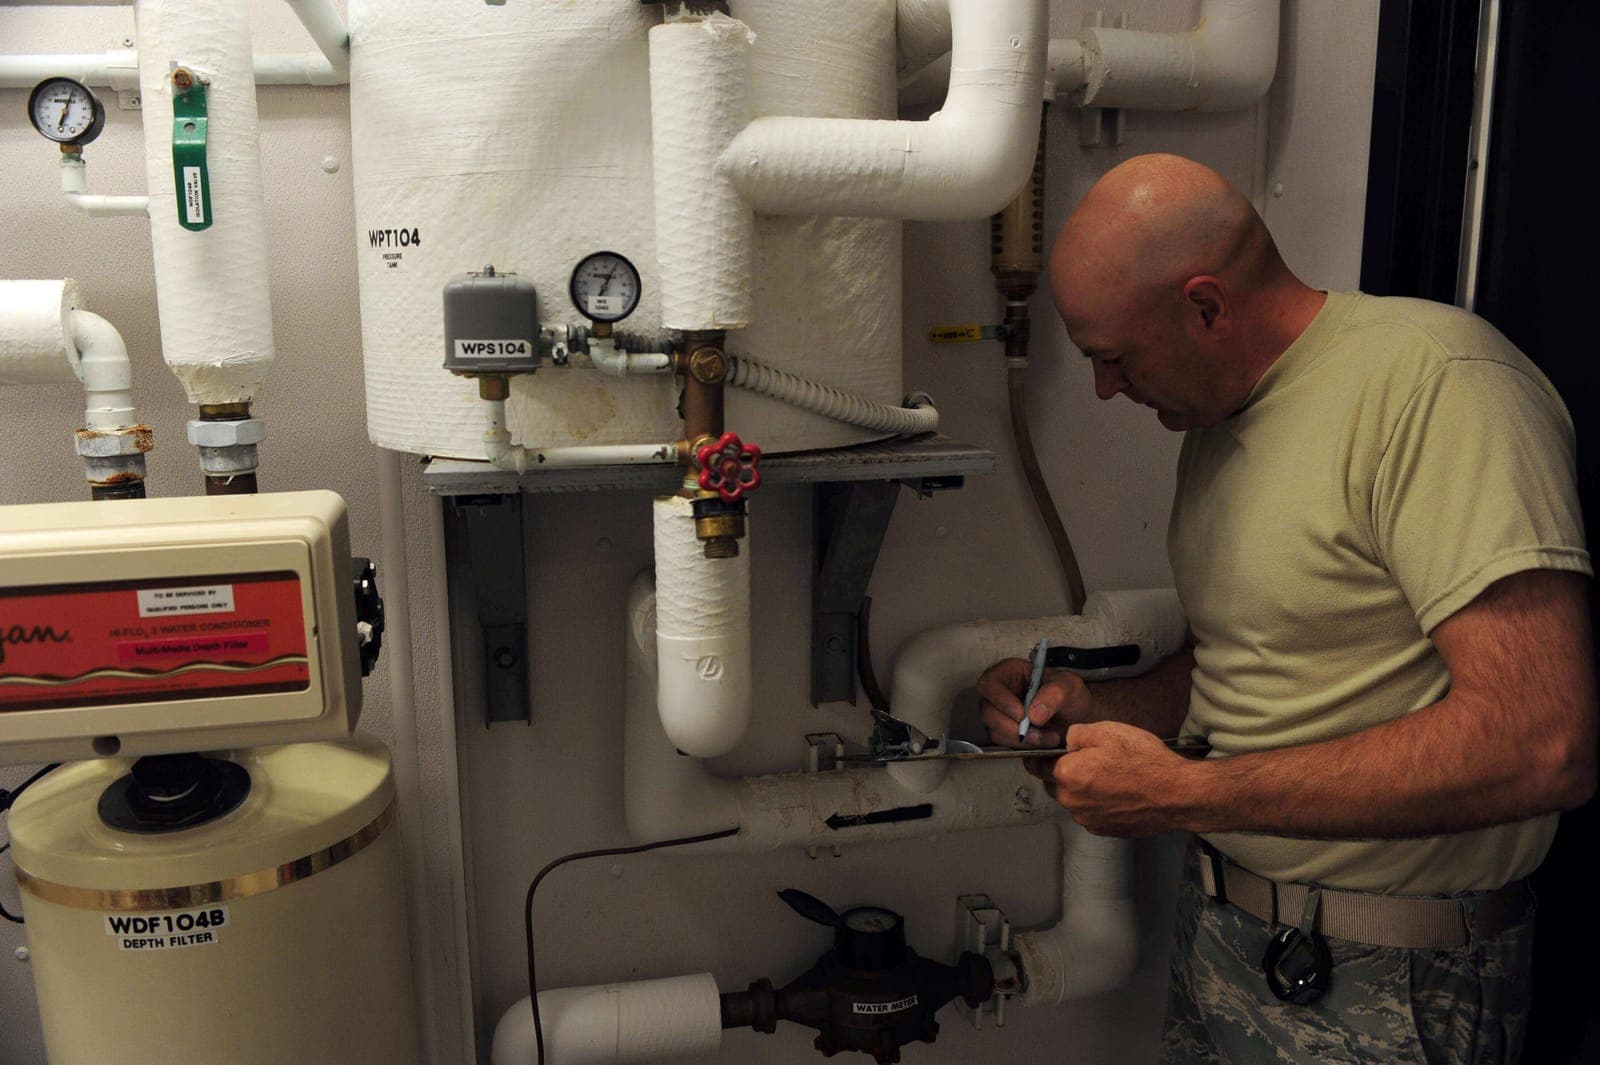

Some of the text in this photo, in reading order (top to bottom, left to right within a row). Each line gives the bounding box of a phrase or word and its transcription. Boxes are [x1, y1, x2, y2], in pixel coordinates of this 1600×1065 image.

[368, 227, 421, 249] WPT104
[461, 342, 526, 355] WPS104
[161, 623, 198, 635] WATER
[200, 618, 270, 632] CONDITIONER
[194, 641, 221, 653] Depth
[223, 640, 249, 650] Filter
[108, 909, 225, 934] WDF104B
[123, 932, 213, 949] DEPTH FILTER
[856, 997, 916, 1013] WATER METER
